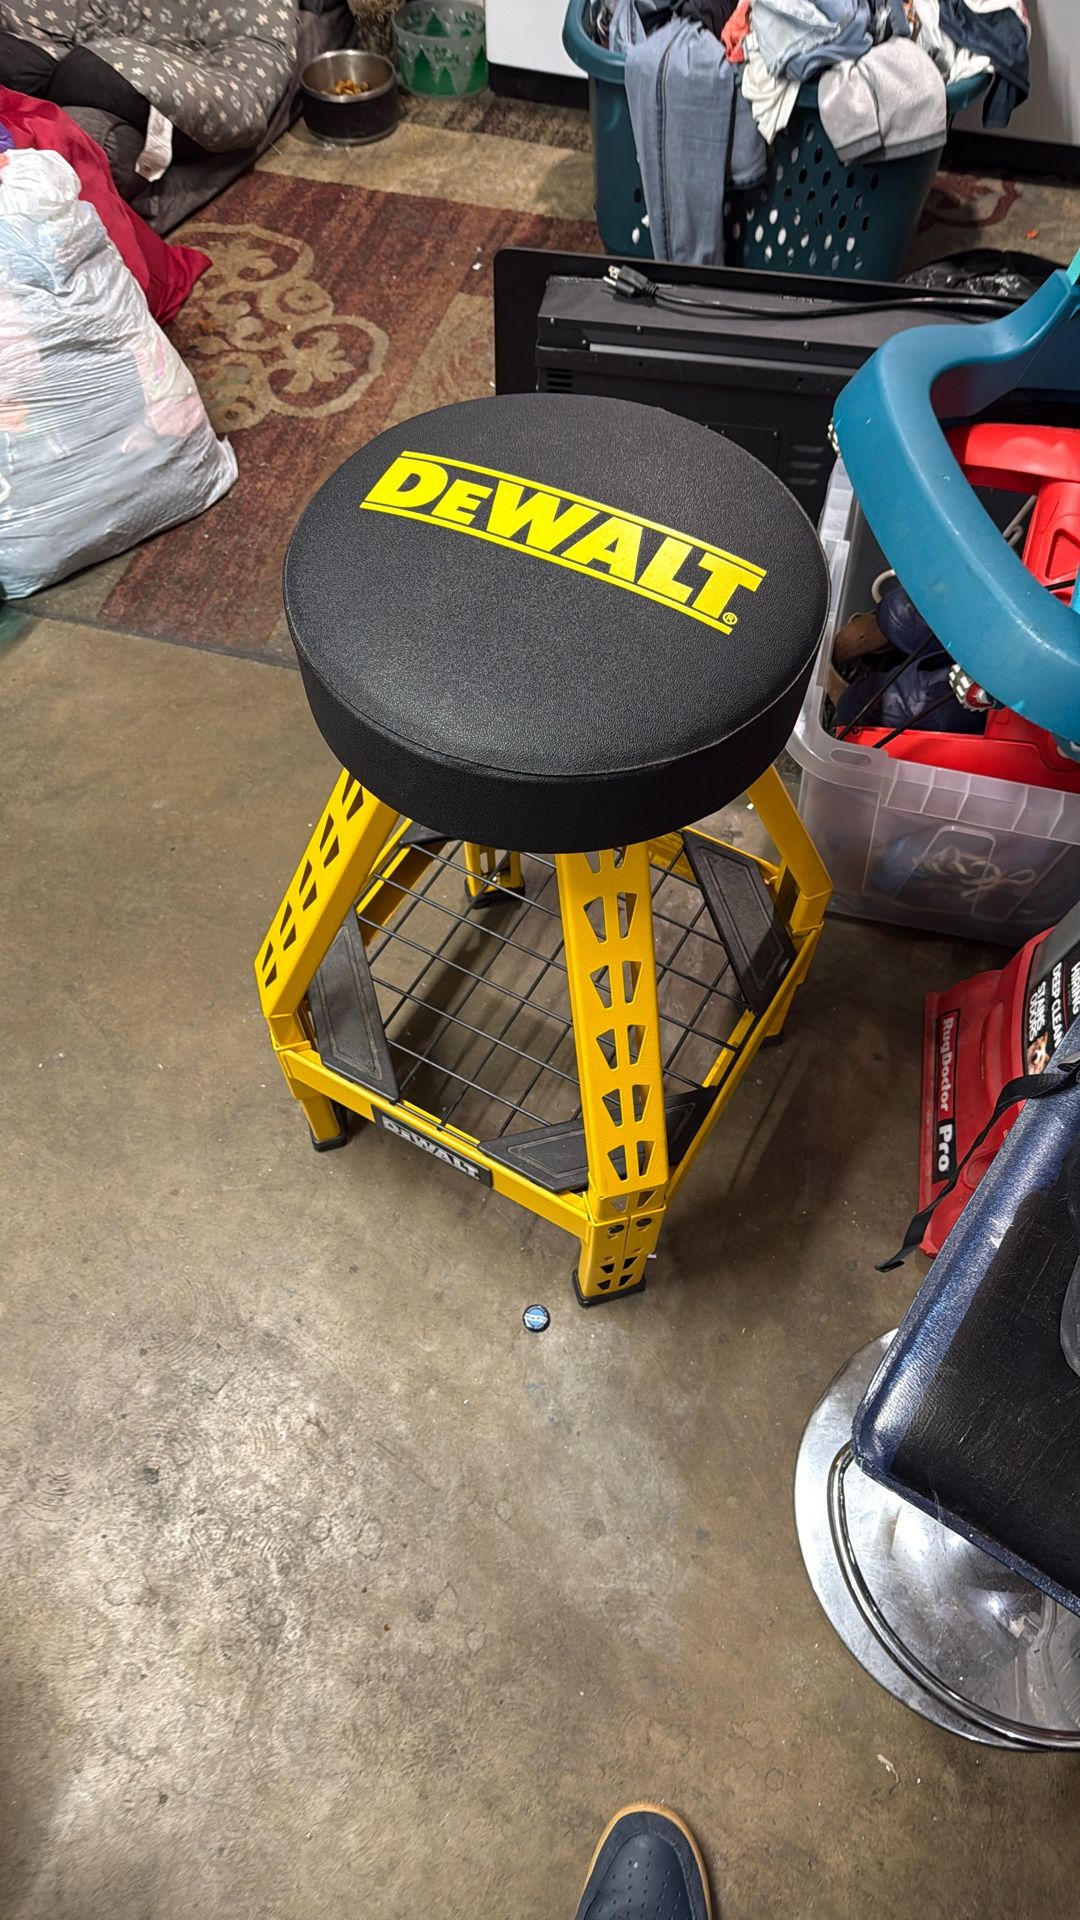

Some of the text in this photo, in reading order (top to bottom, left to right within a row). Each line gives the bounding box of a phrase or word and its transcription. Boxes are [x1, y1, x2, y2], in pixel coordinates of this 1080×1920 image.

[1029, 992, 1038, 1042] ODORS
[1036, 981, 1047, 1031] STAINS
[1052, 962, 1063, 1048] DEEP CLEAN
[938, 1123, 953, 1172] Pro
